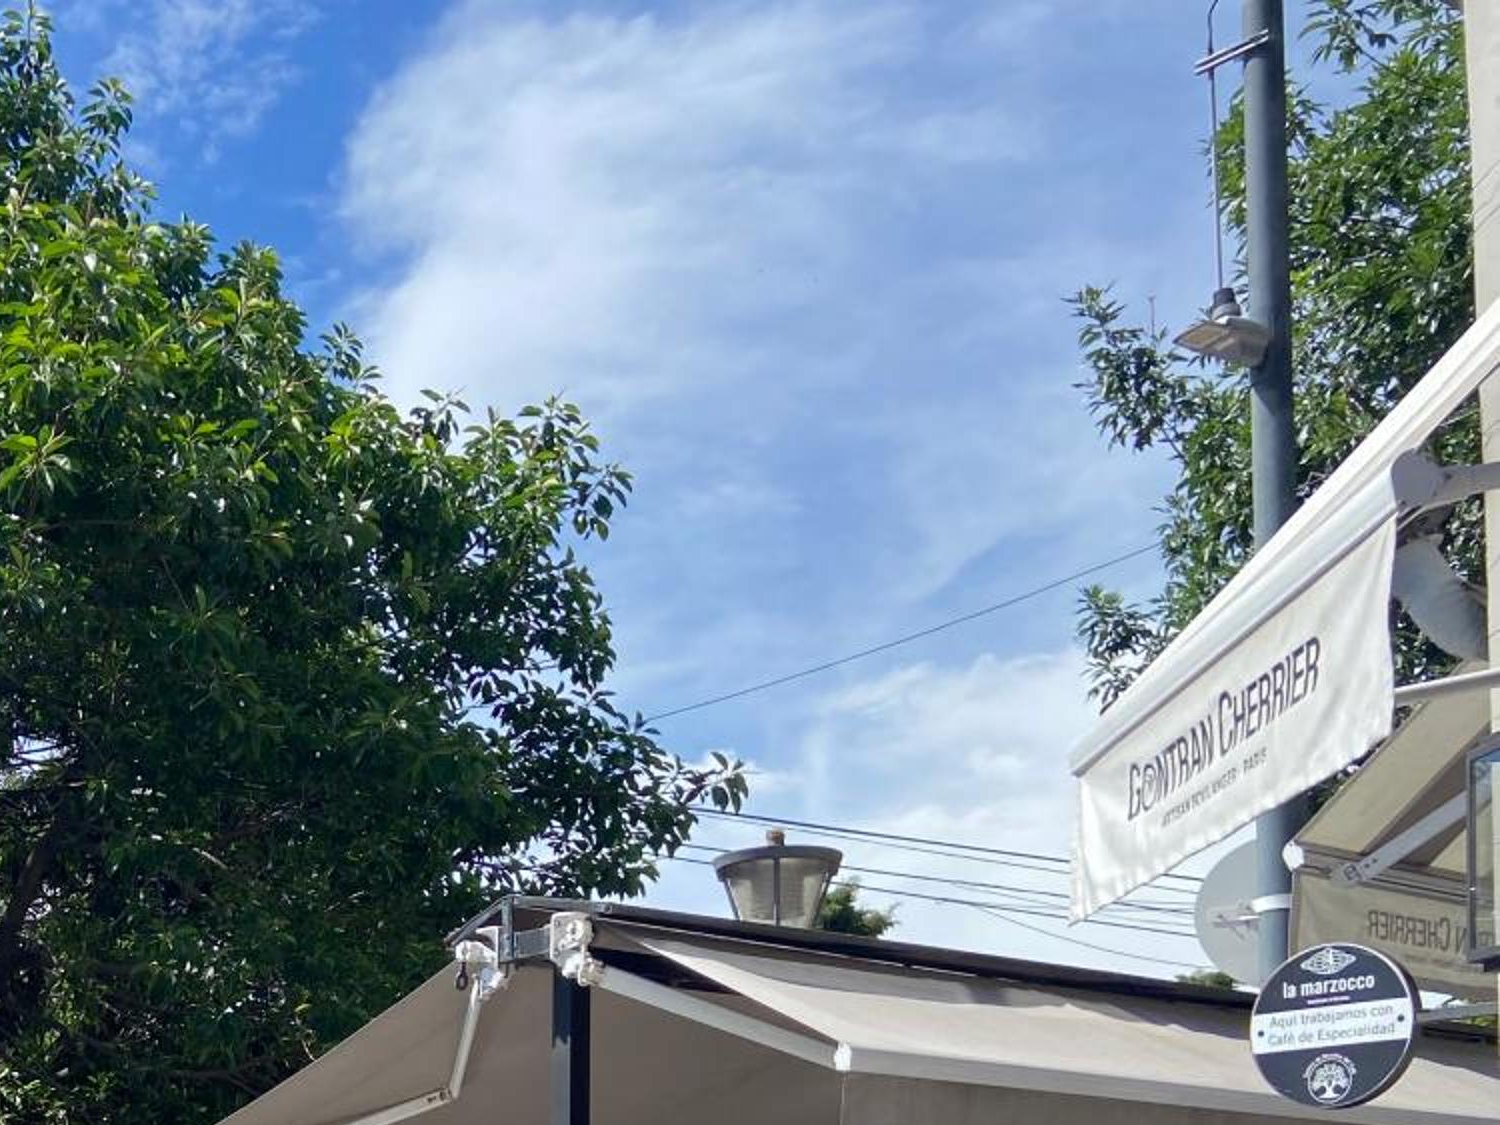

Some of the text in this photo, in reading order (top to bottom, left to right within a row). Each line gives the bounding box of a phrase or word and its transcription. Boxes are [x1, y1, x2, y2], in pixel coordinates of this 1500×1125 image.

[1127, 636, 1321, 821] GONTRAN CHERRIER
[1283, 975, 1376, 999] la marzocco
[1301, 1008, 1367, 1026] trabajamos
[1369, 1004, 1394, 1018] con
[1299, 1028, 1314, 1043] de
[1317, 1022, 1396, 1042] Especialidad
